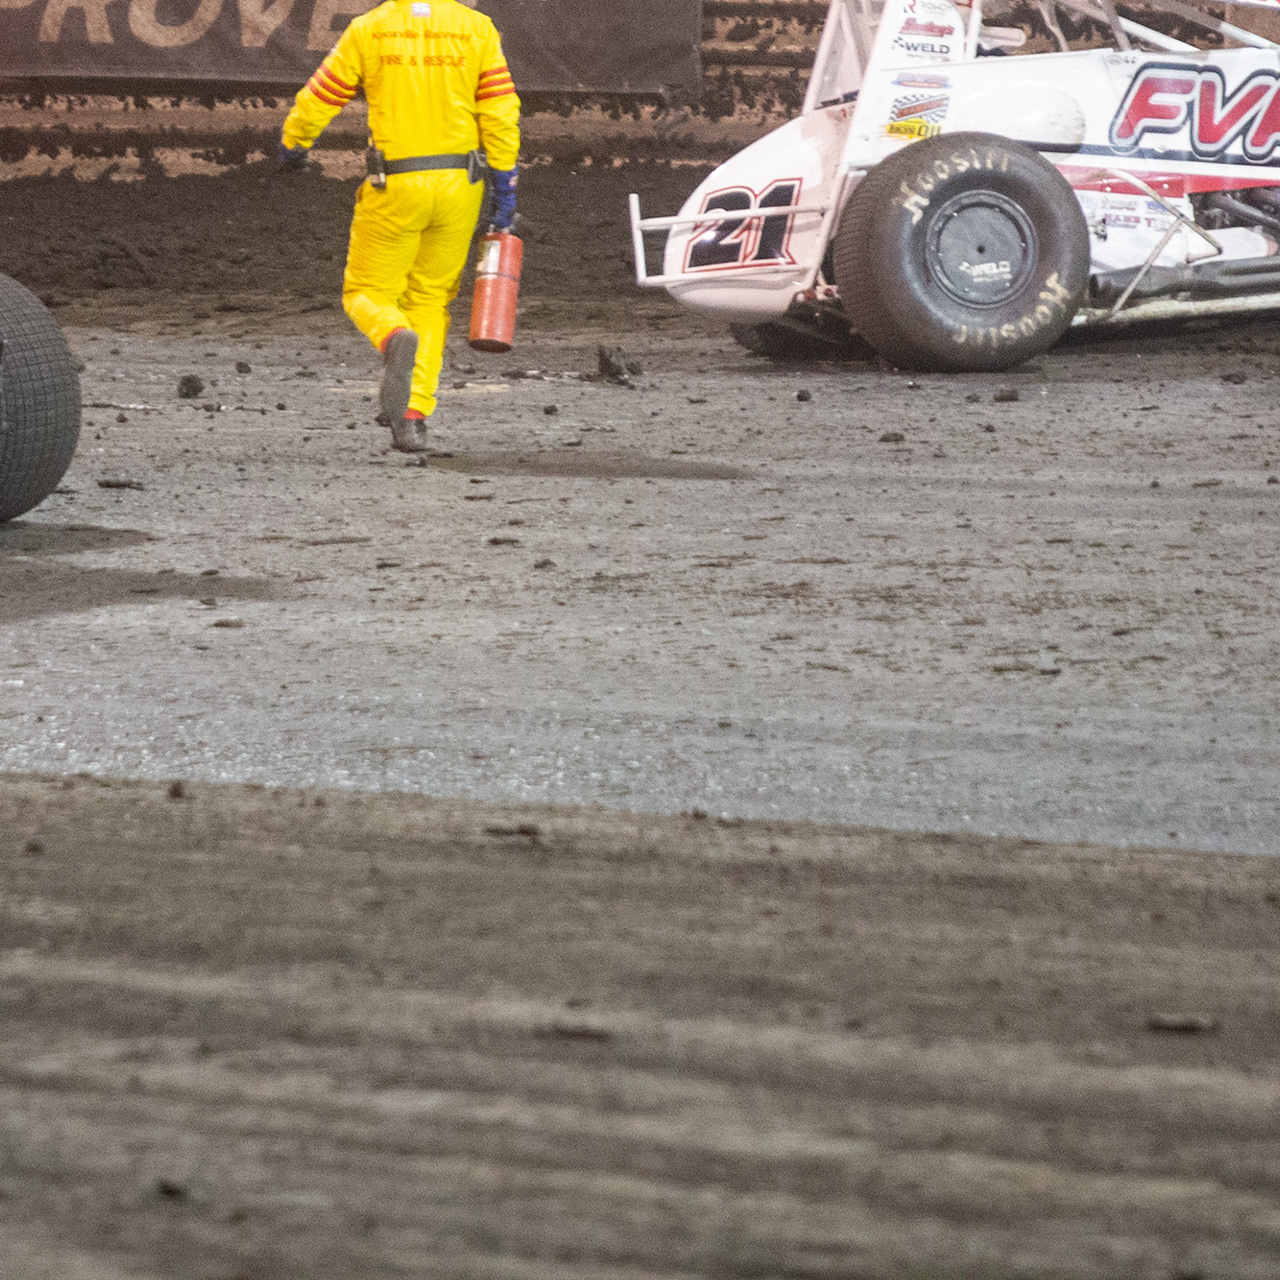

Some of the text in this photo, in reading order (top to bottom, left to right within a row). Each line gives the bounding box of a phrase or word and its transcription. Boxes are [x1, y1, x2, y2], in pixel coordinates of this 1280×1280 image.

[905, 41, 951, 55] WELD
[380, 54, 403, 66] FIRE
[423, 54, 466, 68] RESCUE
[682, 176, 803, 274] 21
